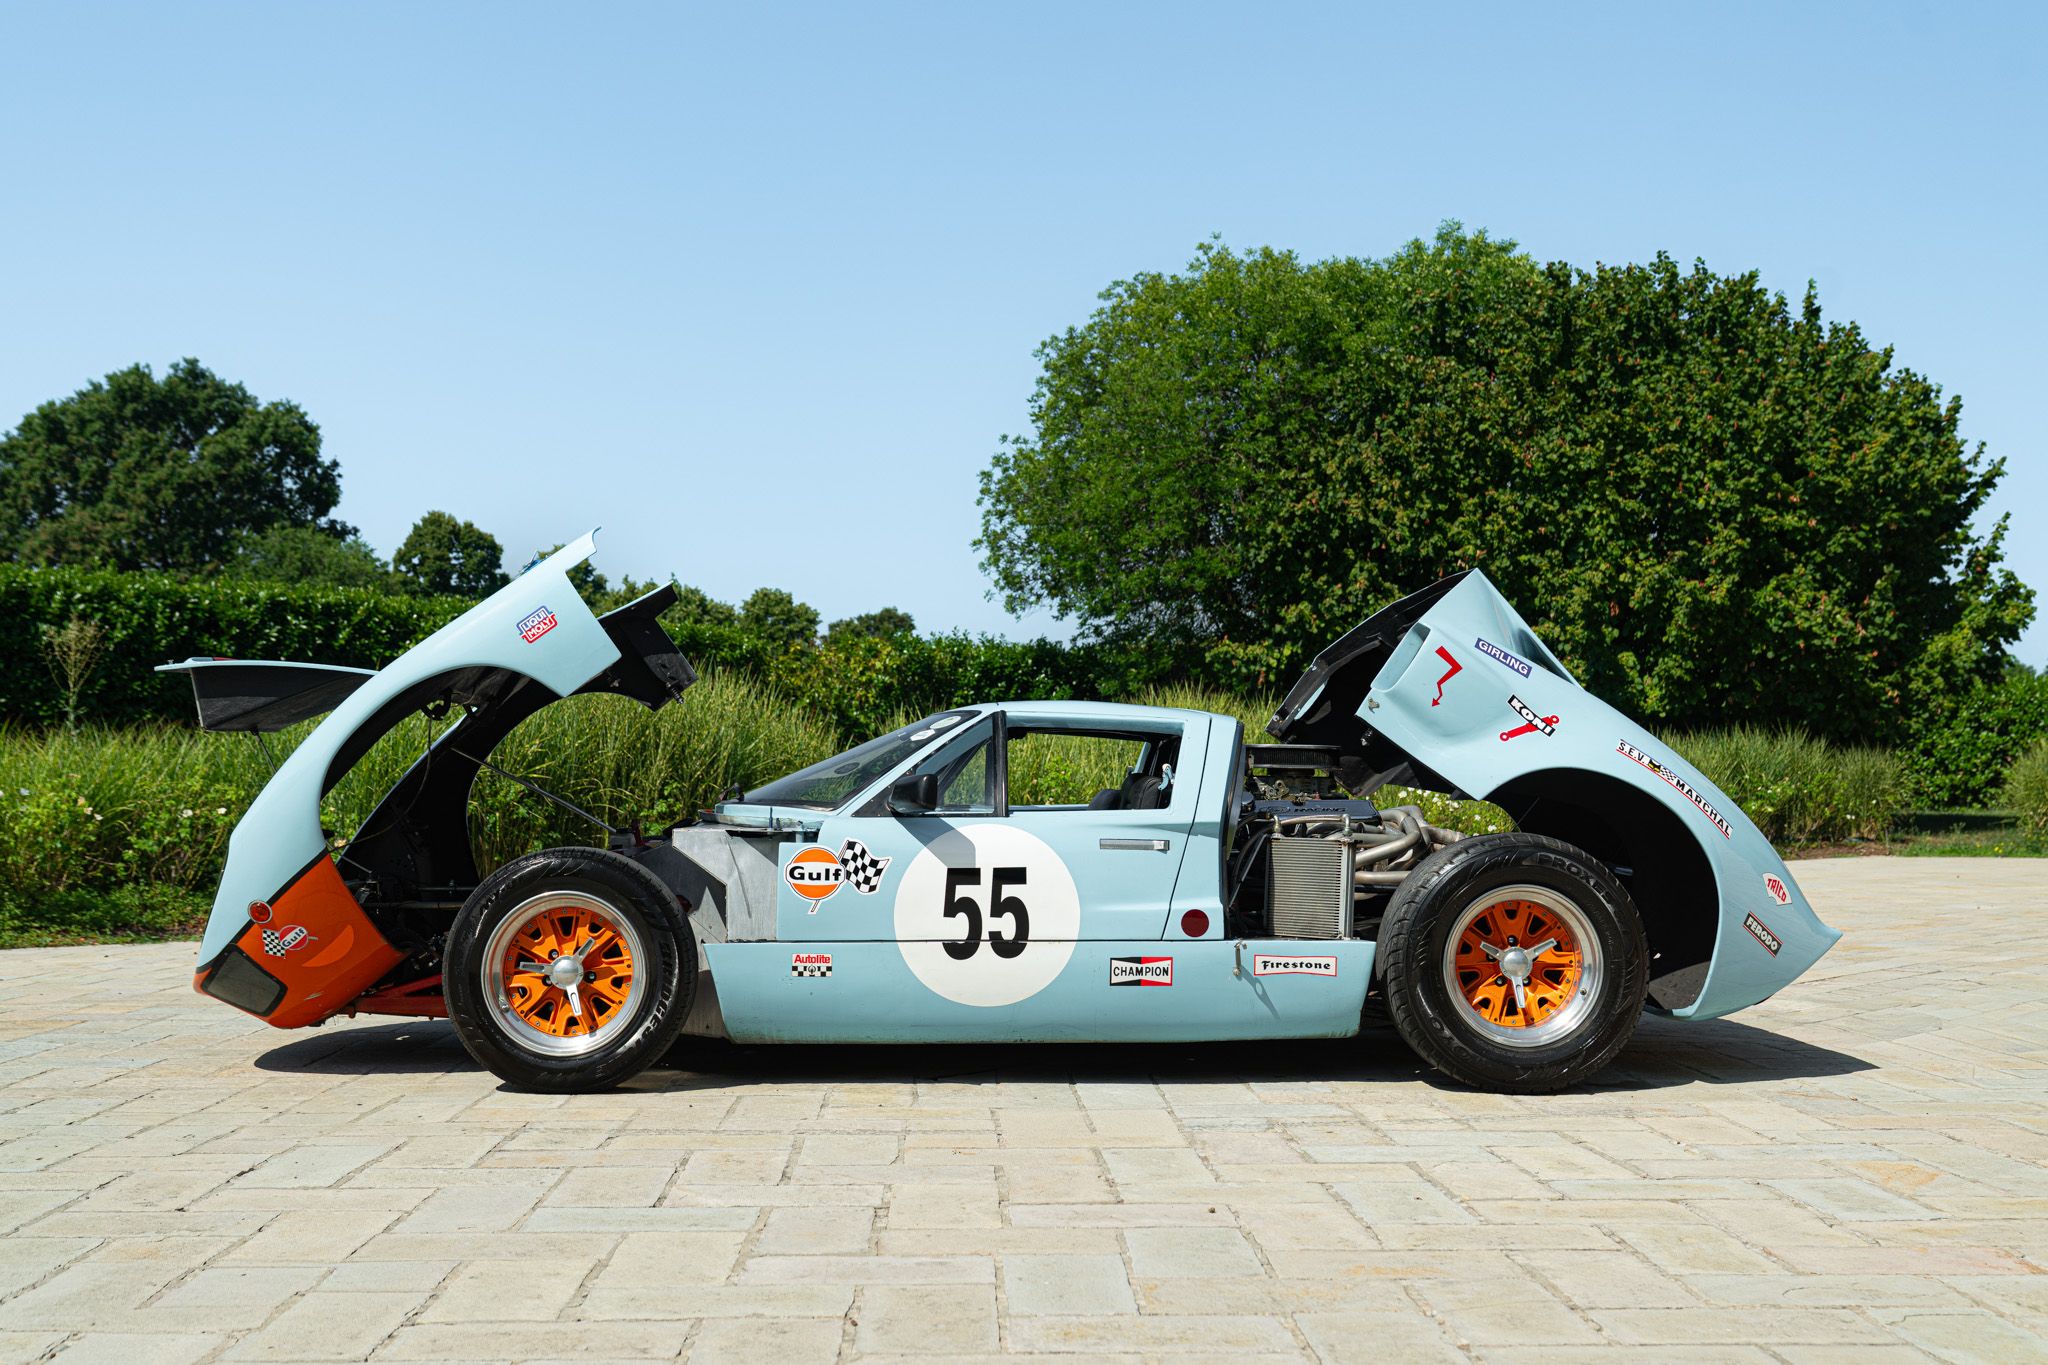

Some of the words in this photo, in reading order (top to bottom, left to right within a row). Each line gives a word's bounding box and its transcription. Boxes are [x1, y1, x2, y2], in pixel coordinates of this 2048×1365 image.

[521, 610, 548, 631] LIQUI
[527, 617, 552, 638] MOLY
[1478, 640, 1528, 675] GIRLING
[1510, 698, 1553, 734] KONI
[1618, 742, 1645, 764] S.E.V.
[1675, 779, 1730, 836] MARCHAL
[788, 866, 842, 881] Gulf
[1767, 878, 1787, 902] TRICO
[942, 867, 1030, 960] 55
[281, 928, 305, 948] Gulf
[1746, 916, 1778, 951] FERODO
[794, 954, 831, 964] Autolite
[1261, 960, 1331, 970] Firestone
[1113, 966, 1169, 977] CHAMPION
